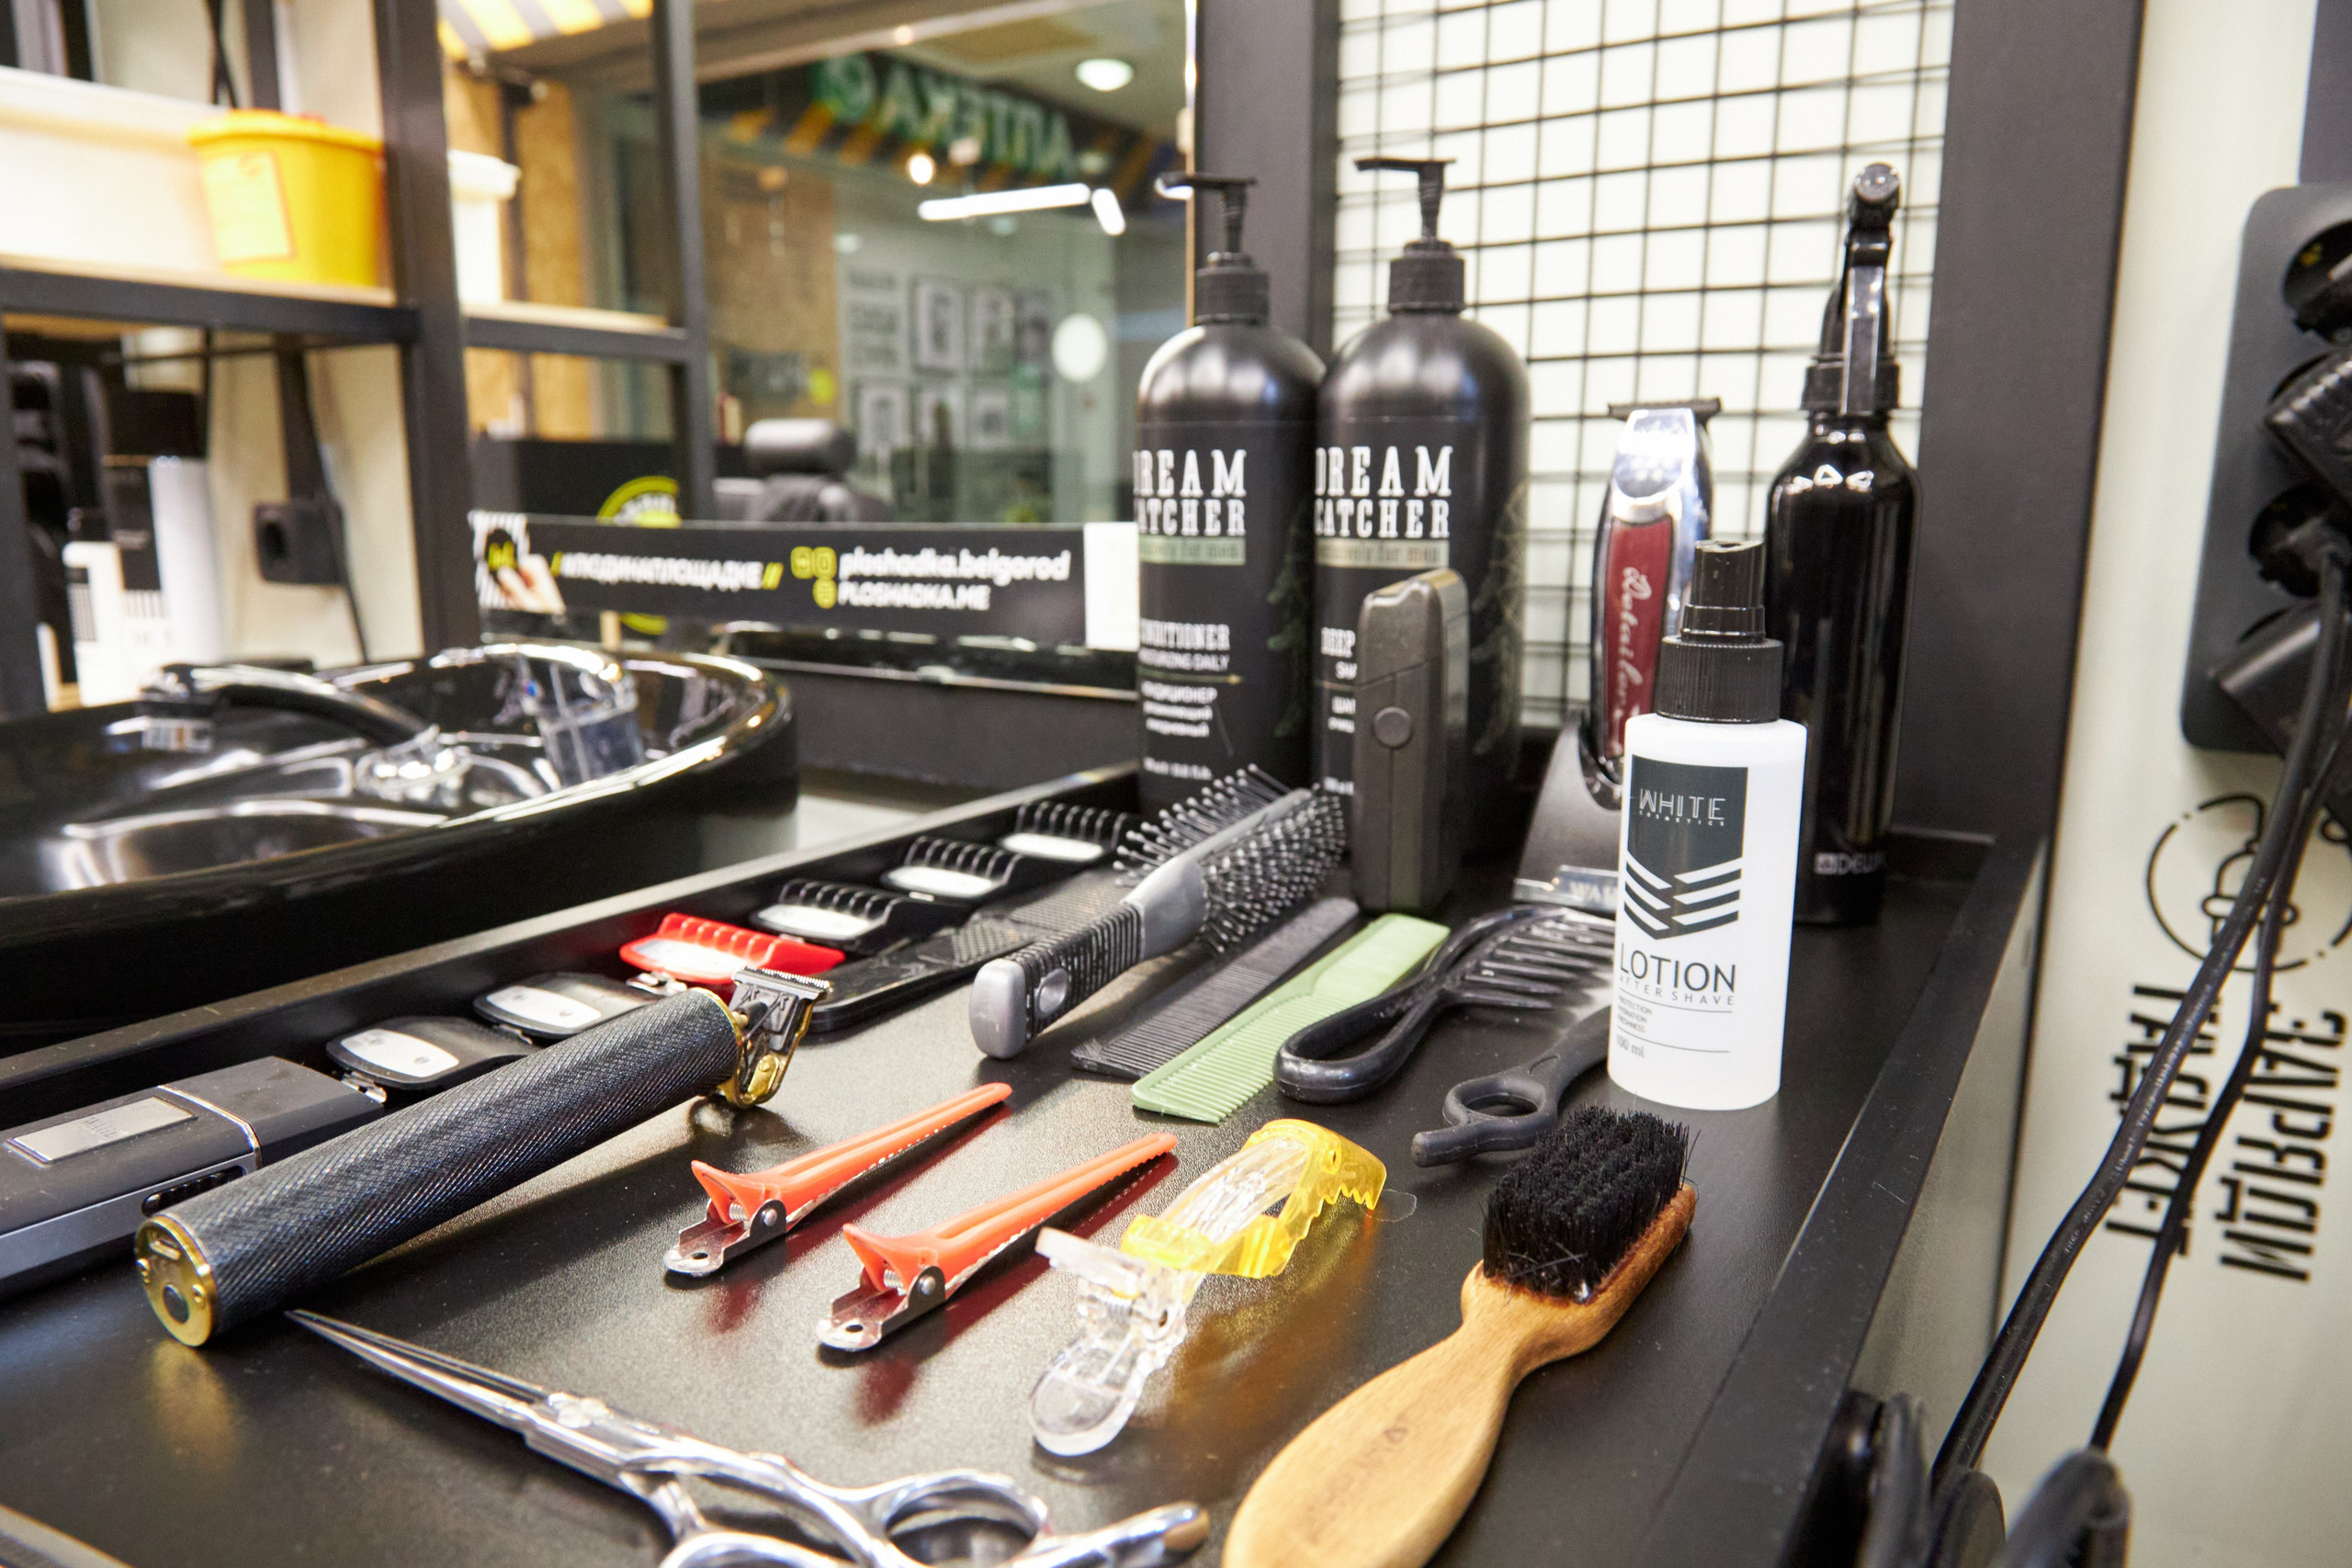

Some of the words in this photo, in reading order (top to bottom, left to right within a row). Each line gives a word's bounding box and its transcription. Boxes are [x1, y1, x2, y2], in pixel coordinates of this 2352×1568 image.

[1134, 498, 1246, 536] ATCHER
[1638, 788, 1726, 821] WHITE
[1620, 942, 1736, 993] LOTION
[1620, 974, 1663, 998] AFTER
[1671, 991, 1735, 1006] SHAVE
